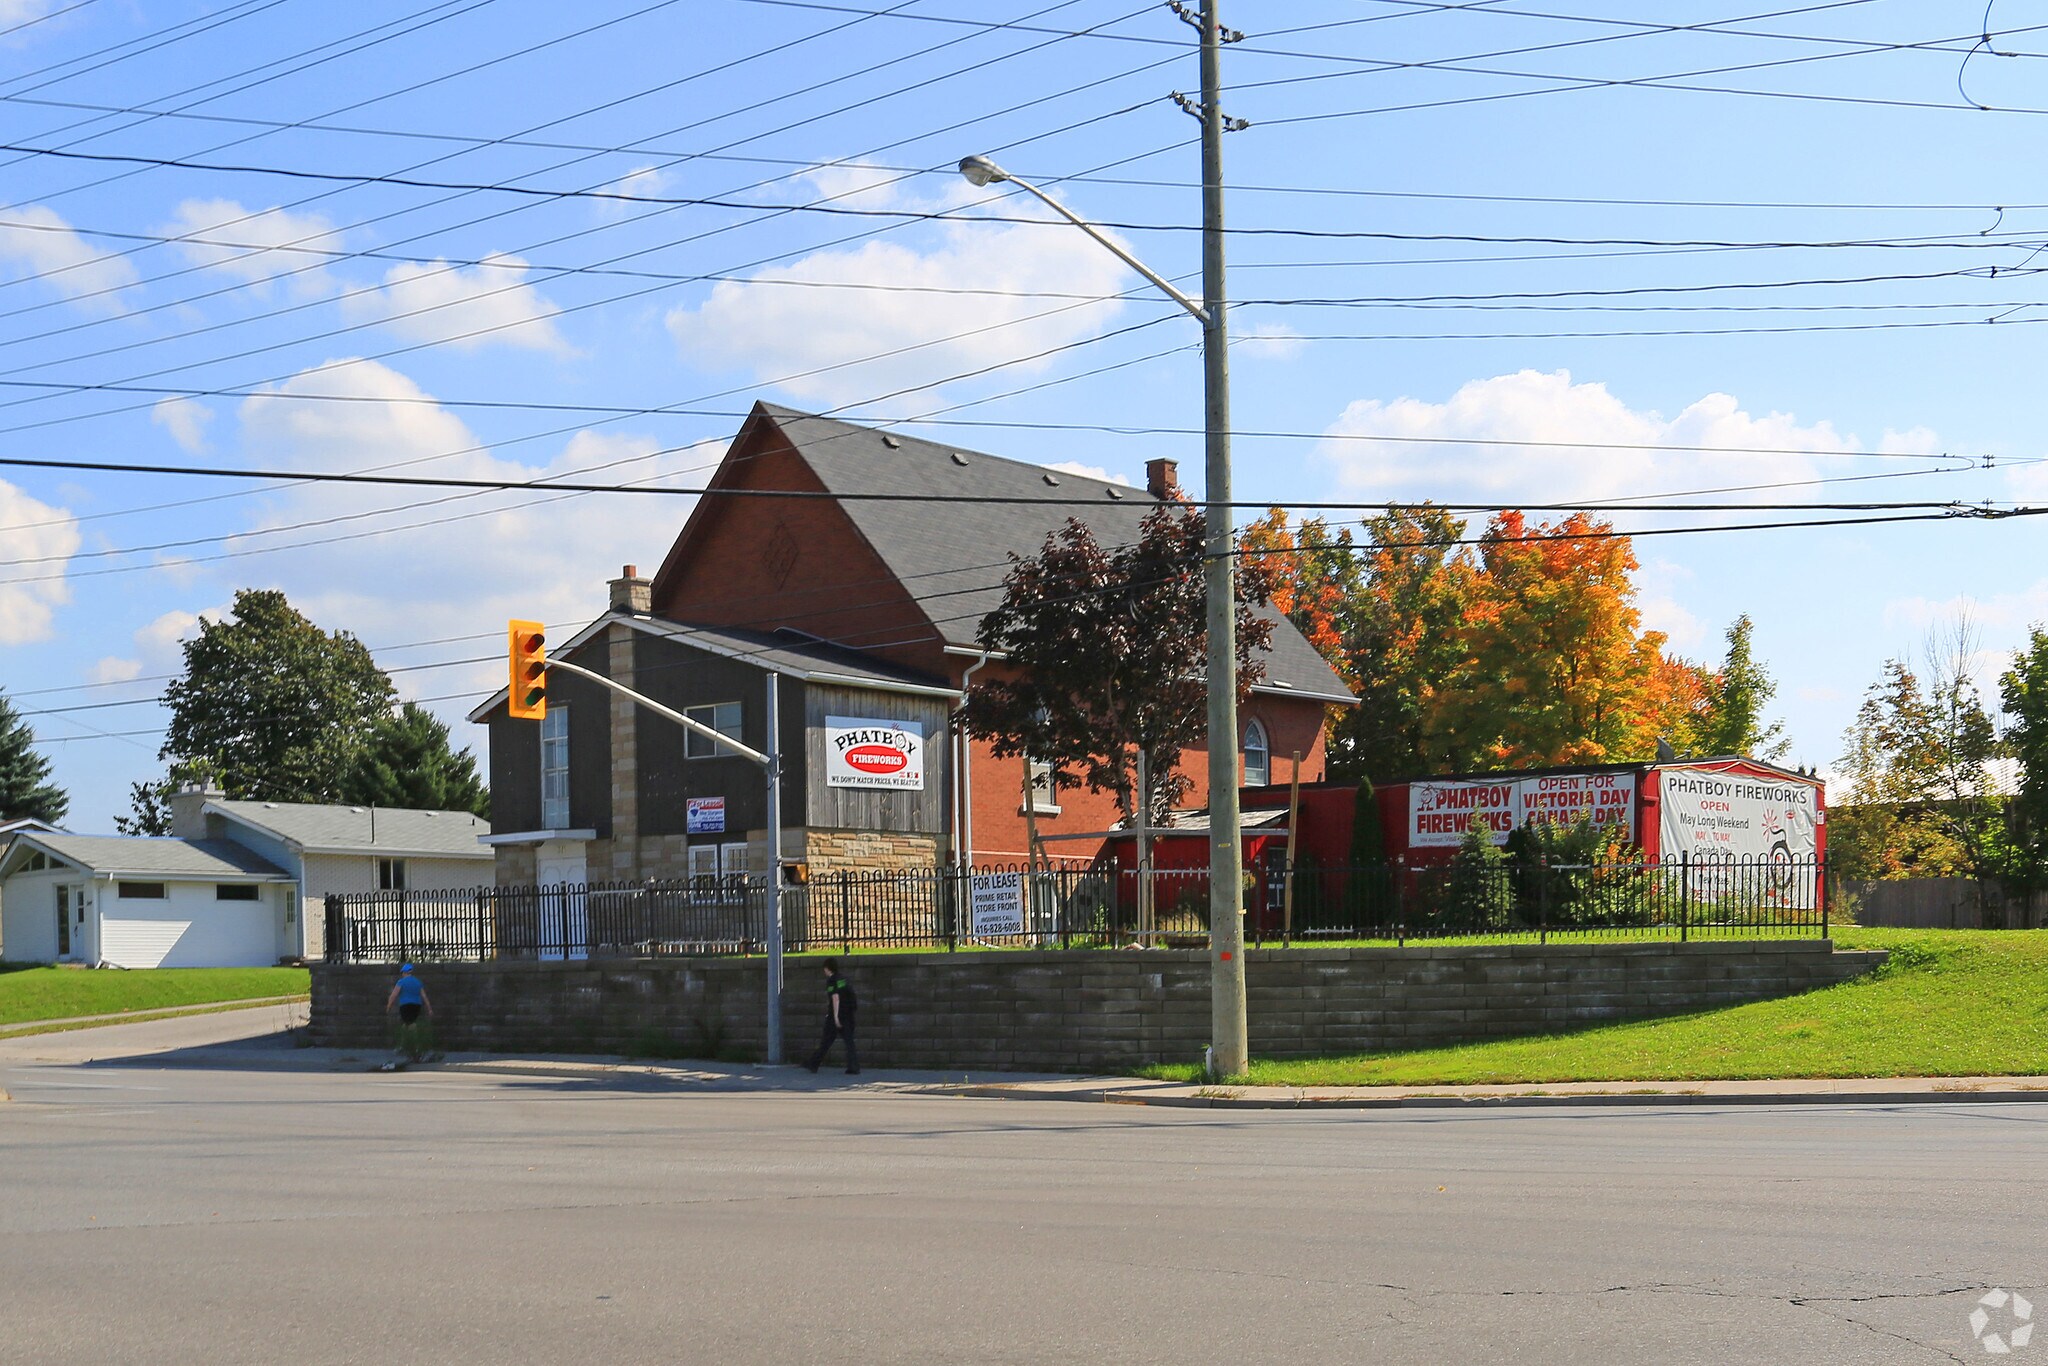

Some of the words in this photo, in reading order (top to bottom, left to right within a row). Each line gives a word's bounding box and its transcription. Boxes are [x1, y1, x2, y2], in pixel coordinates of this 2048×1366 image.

[835, 730, 916, 755] PHATBOY
[852, 753, 903, 766] FIREWORKS
[831, 775, 840, 784] WE
[840, 775, 856, 785] DON'T
[857, 776, 874, 785] MATCH
[892, 778, 899, 786] WE
[1538, 776, 1579, 791] OPEN
[1585, 775, 1615, 789] FOR
[1436, 785, 1512, 810] PHATBOY
[1523, 790, 1595, 809] VICTORIA
[1599, 788, 1631, 806] DAY
[1669, 777, 1732, 798] PHATBOY
[1735, 784, 1807, 804] FIREWORKS
[1700, 800, 1730, 812] OPEN
[1528, 807, 1591, 825] CANAD
[1680, 812, 1696, 826] May
[1697, 814, 1716, 829] Long
[1717, 815, 1749, 829] Weekend
[1695, 831, 1707, 841] MAY
[1713, 831, 1719, 842] TO
[1720, 832, 1731, 843] MAY
[1694, 844, 1719, 855] Canada
[1720, 846, 1732, 860] Day
[973, 877, 990, 891] FOR
[991, 874, 1018, 889] LEASE
[975, 893, 996, 902] PRIME
[996, 892, 1018, 901] RETAIL
[976, 903, 997, 913] STORE
[997, 901, 1018, 911] FRONT
